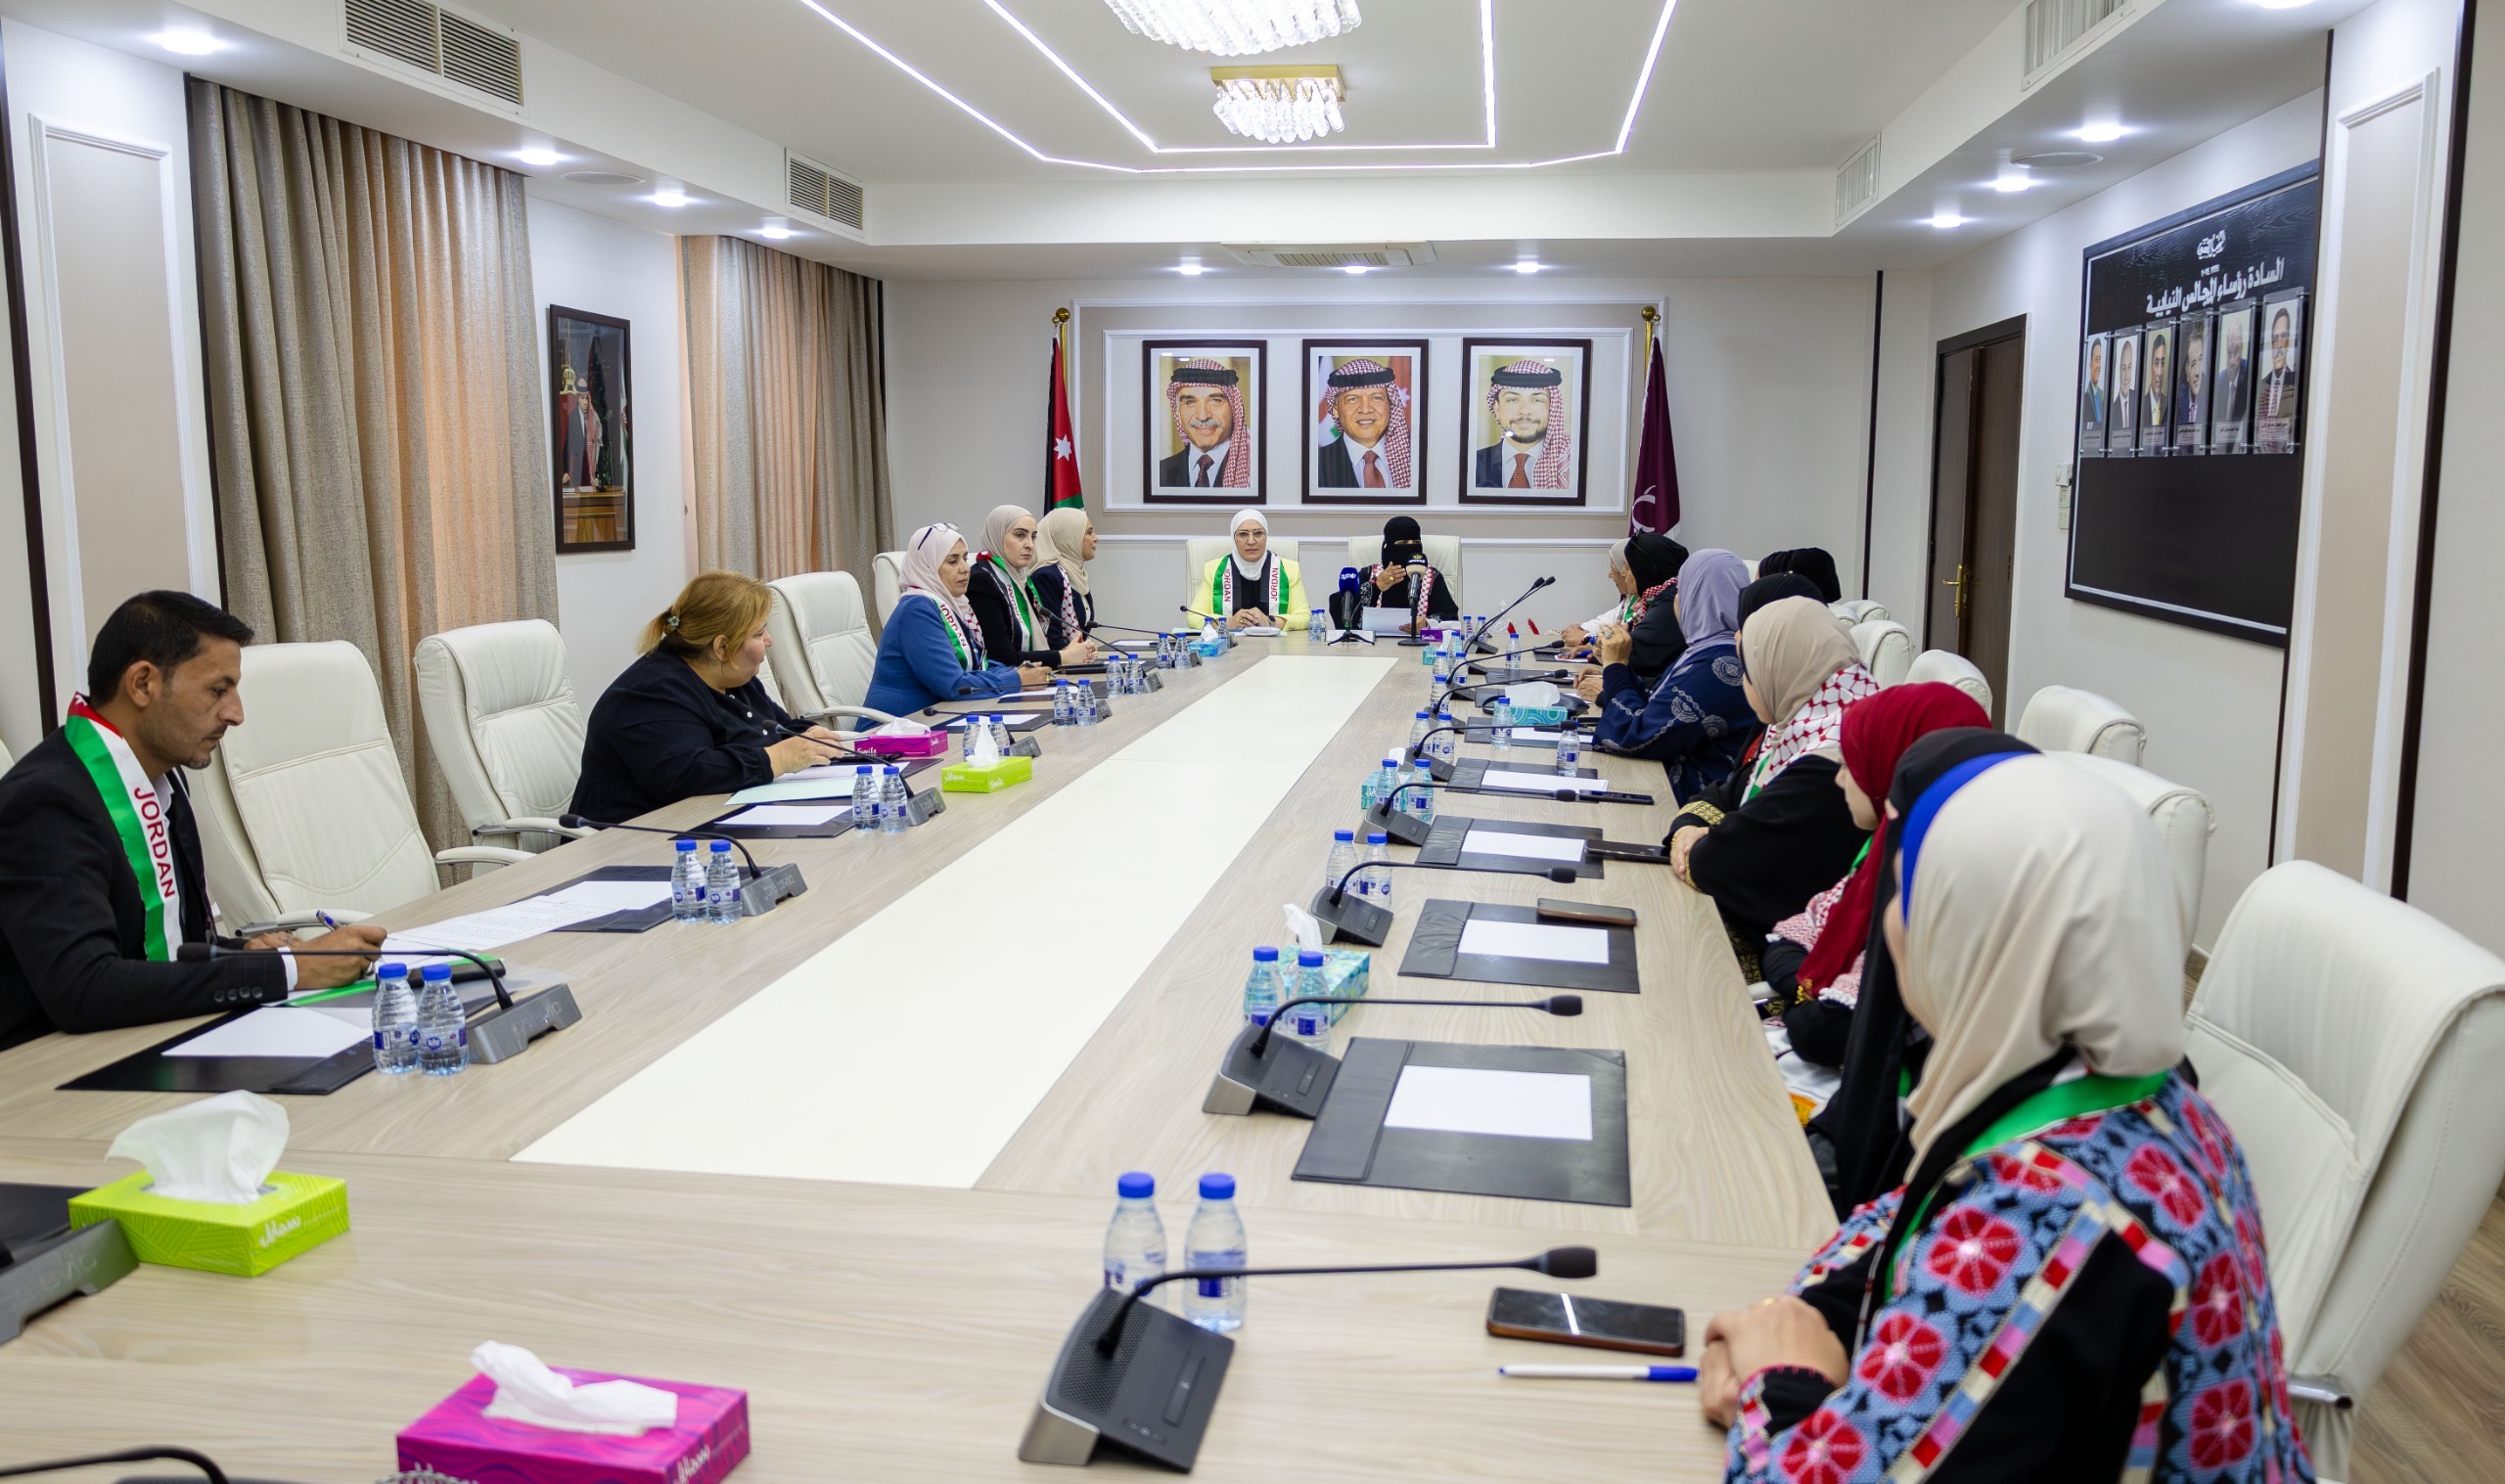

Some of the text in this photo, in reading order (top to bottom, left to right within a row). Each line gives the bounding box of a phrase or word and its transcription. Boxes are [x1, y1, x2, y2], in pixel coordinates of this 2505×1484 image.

[2216, 270, 2247, 302] رؤساء
[2248, 256, 2285, 290] السادة
[2146, 286, 2182, 318] النيابية
[2181, 276, 2218, 312] المجالس
[1223, 568, 1232, 603] JORDAN
[1270, 567, 1279, 602] JORDAN
[133, 787, 176, 899] JORDAN
